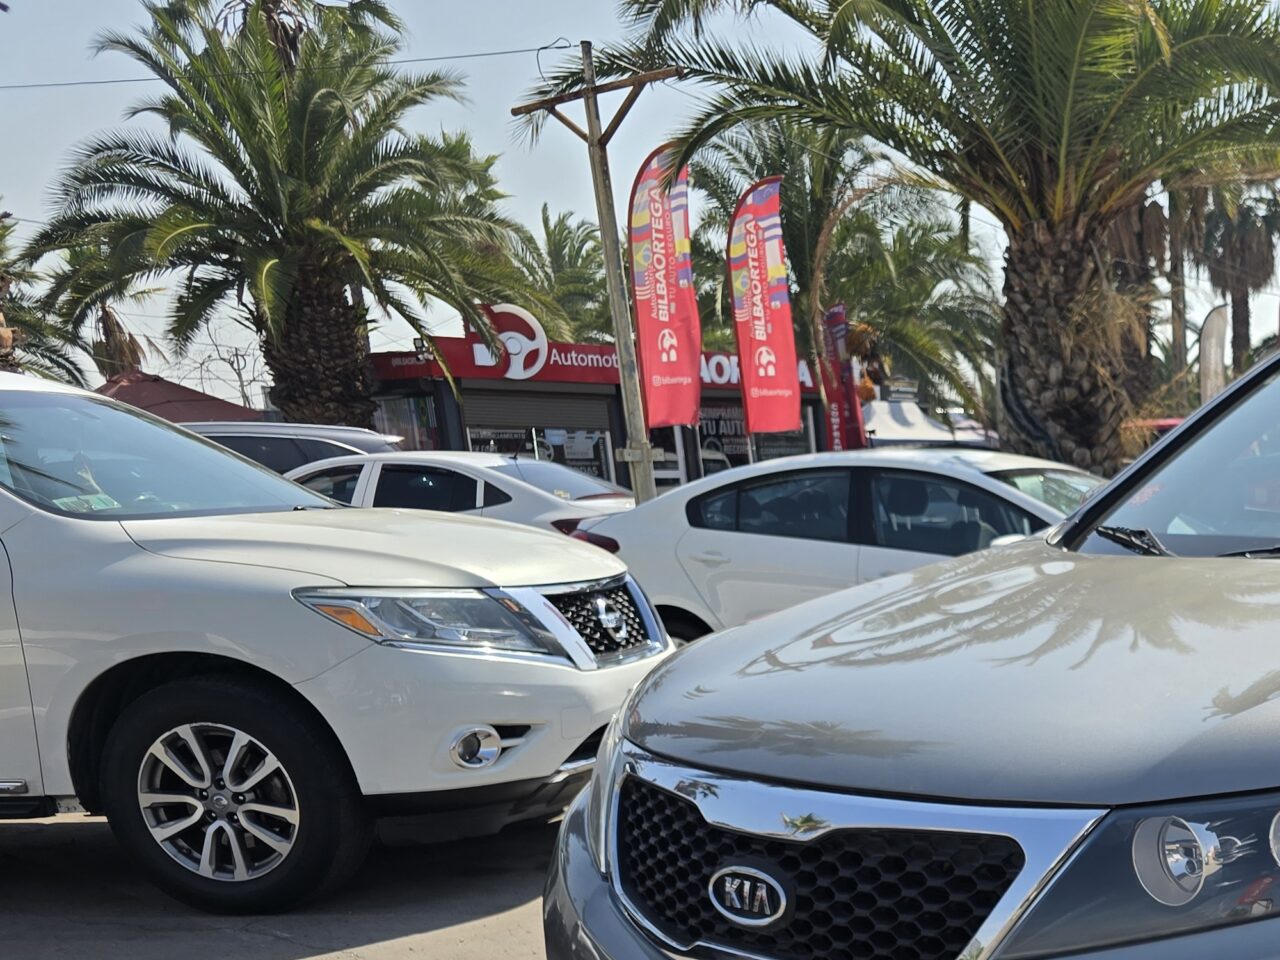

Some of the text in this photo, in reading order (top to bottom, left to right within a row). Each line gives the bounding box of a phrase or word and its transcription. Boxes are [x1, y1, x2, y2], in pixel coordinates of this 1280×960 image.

[665, 212, 674, 254] SEGURO
[649, 188, 669, 322] BILBAORTEGA
[668, 257, 676, 285] AUTO
[746, 219, 767, 341] BILBAORTEGA
[702, 420, 716, 436] TU
[724, 876, 771, 916] KIA
